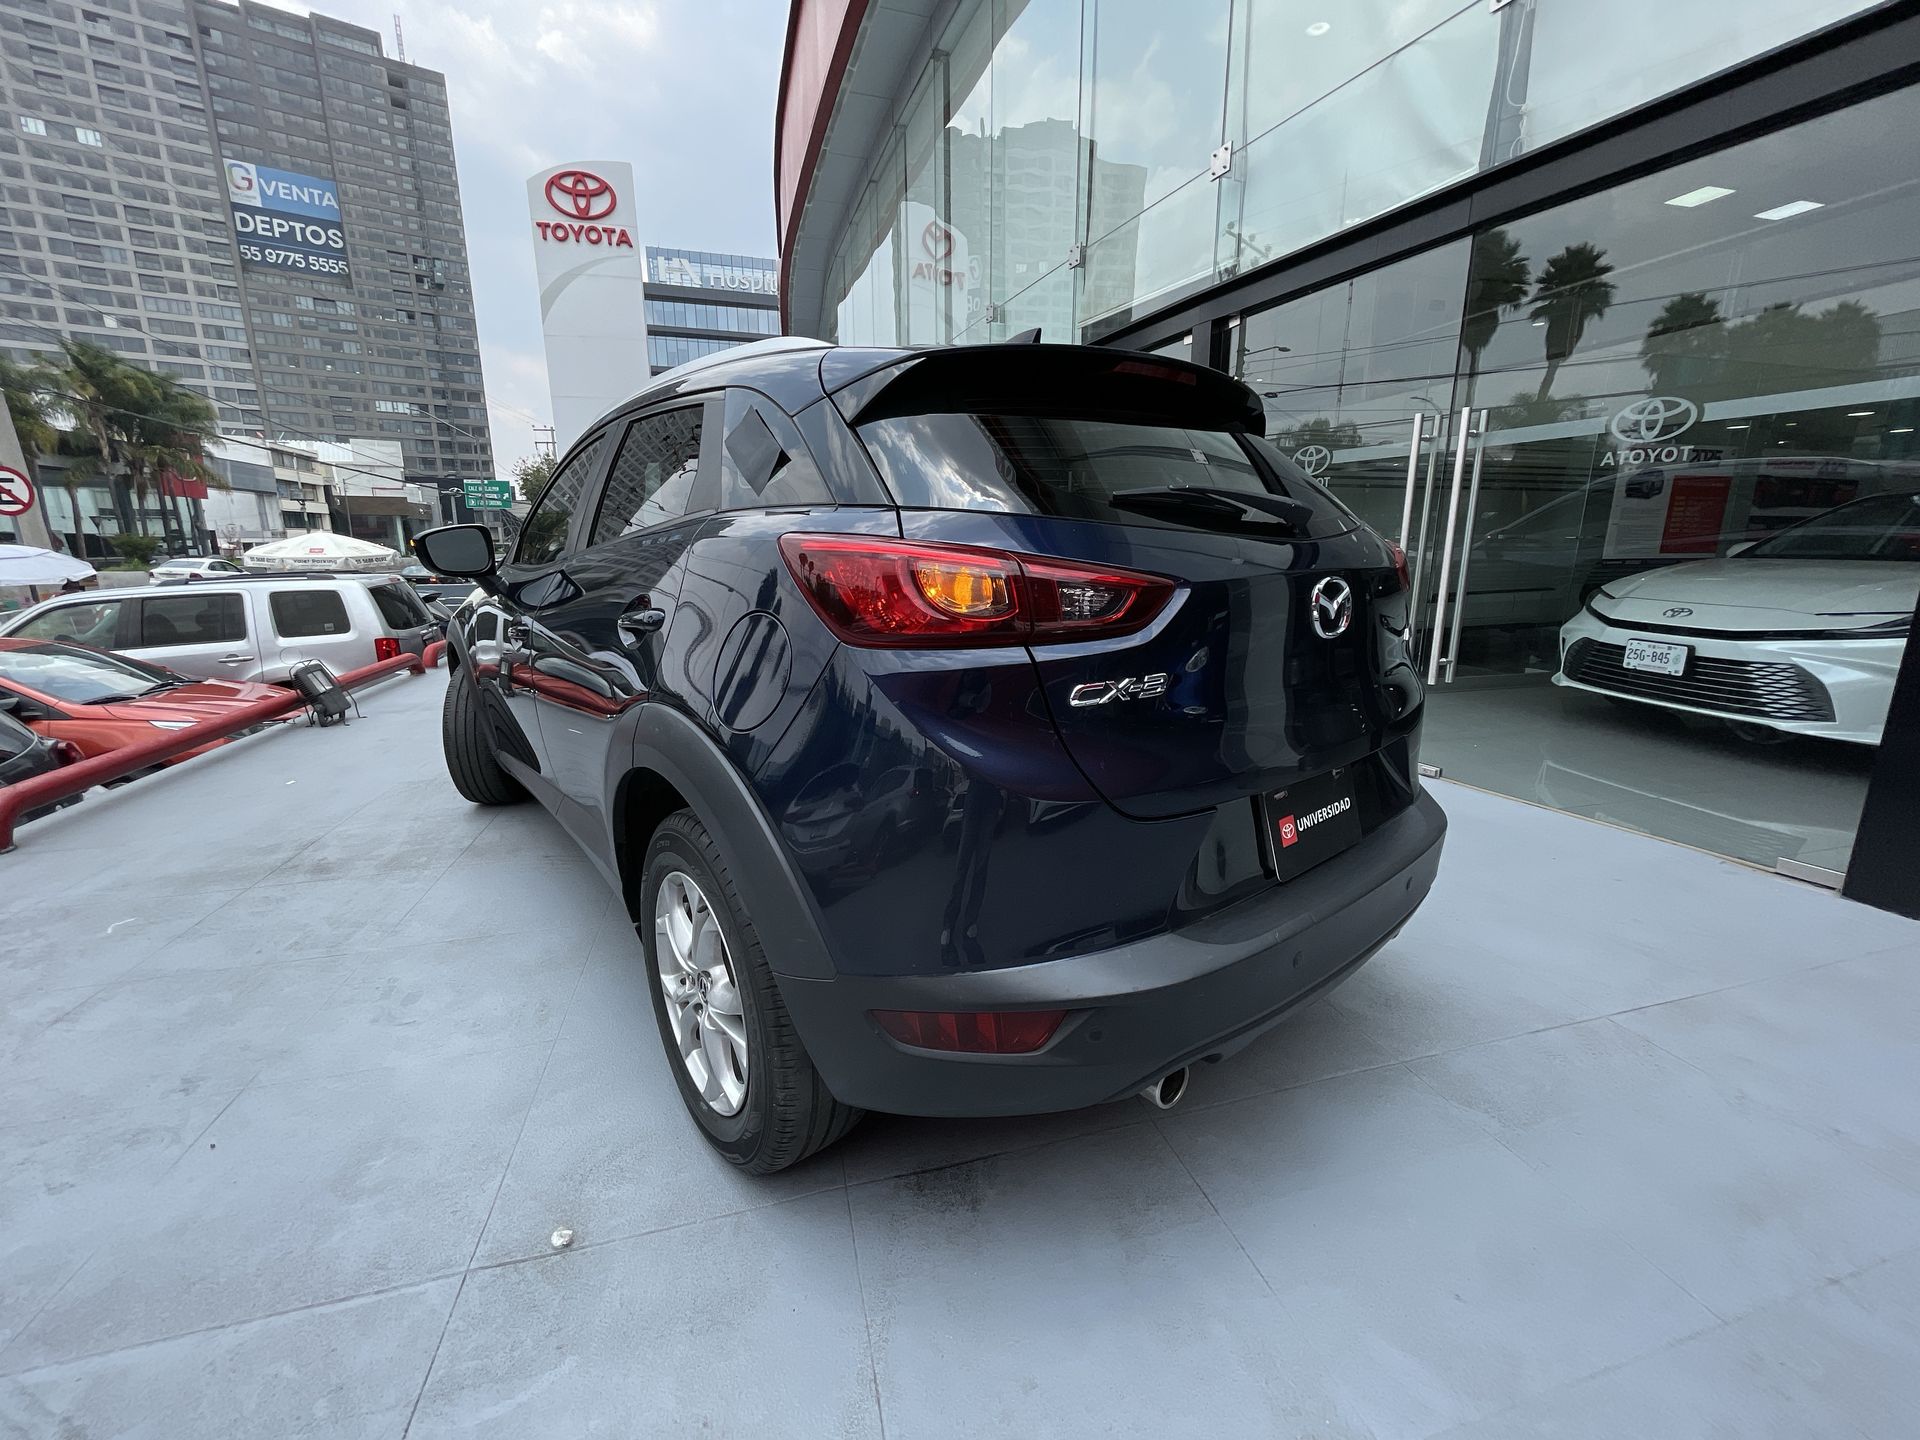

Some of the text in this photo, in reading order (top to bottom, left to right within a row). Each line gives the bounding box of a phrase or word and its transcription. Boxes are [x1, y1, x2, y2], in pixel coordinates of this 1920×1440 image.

[259, 178, 339, 209] VENTA
[234, 211, 344, 249] DEPTOS
[536, 221, 633, 248] TOYOTA
[240, 245, 349, 275] 55 9775 5555
[1626, 648, 1671, 664] 25G-845
[1069, 672, 1168, 707] CX-3
[1296, 797, 1352, 832] UNIVERSIDAD
